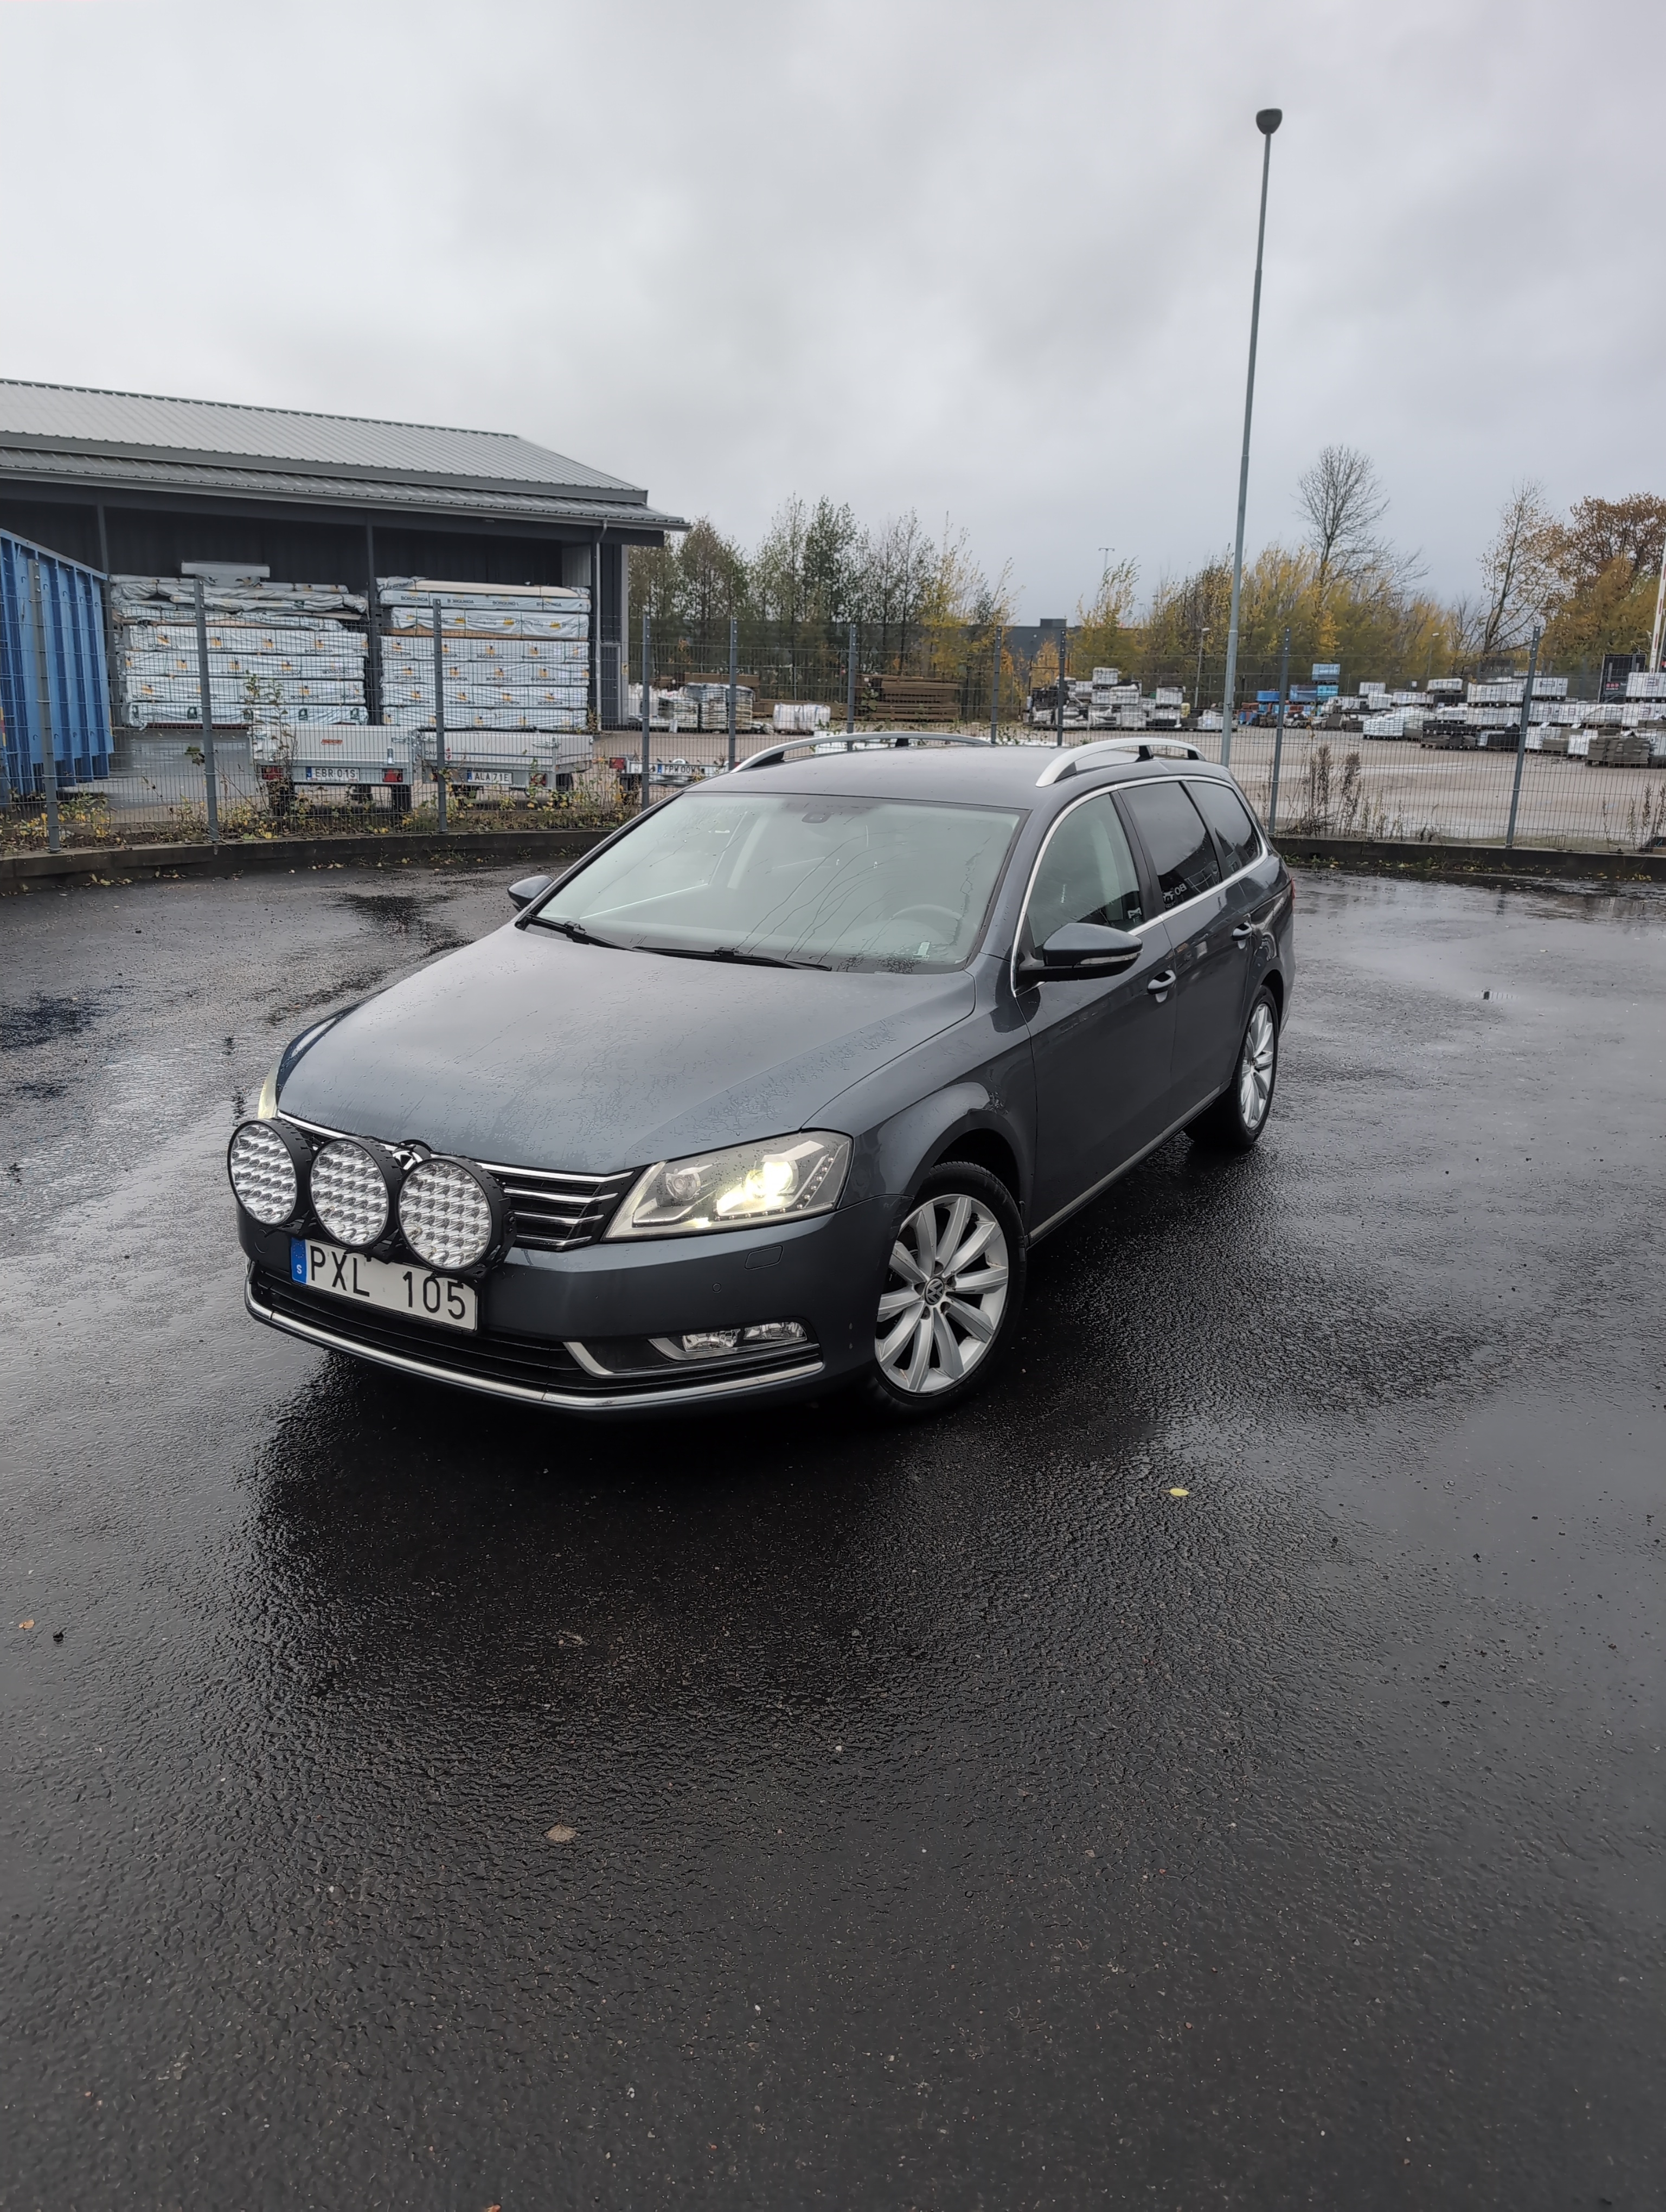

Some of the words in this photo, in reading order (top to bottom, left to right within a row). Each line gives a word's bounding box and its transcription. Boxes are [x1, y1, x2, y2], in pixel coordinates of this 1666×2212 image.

[315, 768, 334, 777] EBR
[337, 769, 355, 778] 01S
[475, 773, 490, 781] ALA
[493, 773, 509, 781] 71E
[296, 1264, 302, 1275] S
[310, 1245, 370, 1297] PXL
[402, 1271, 466, 1320] 105
